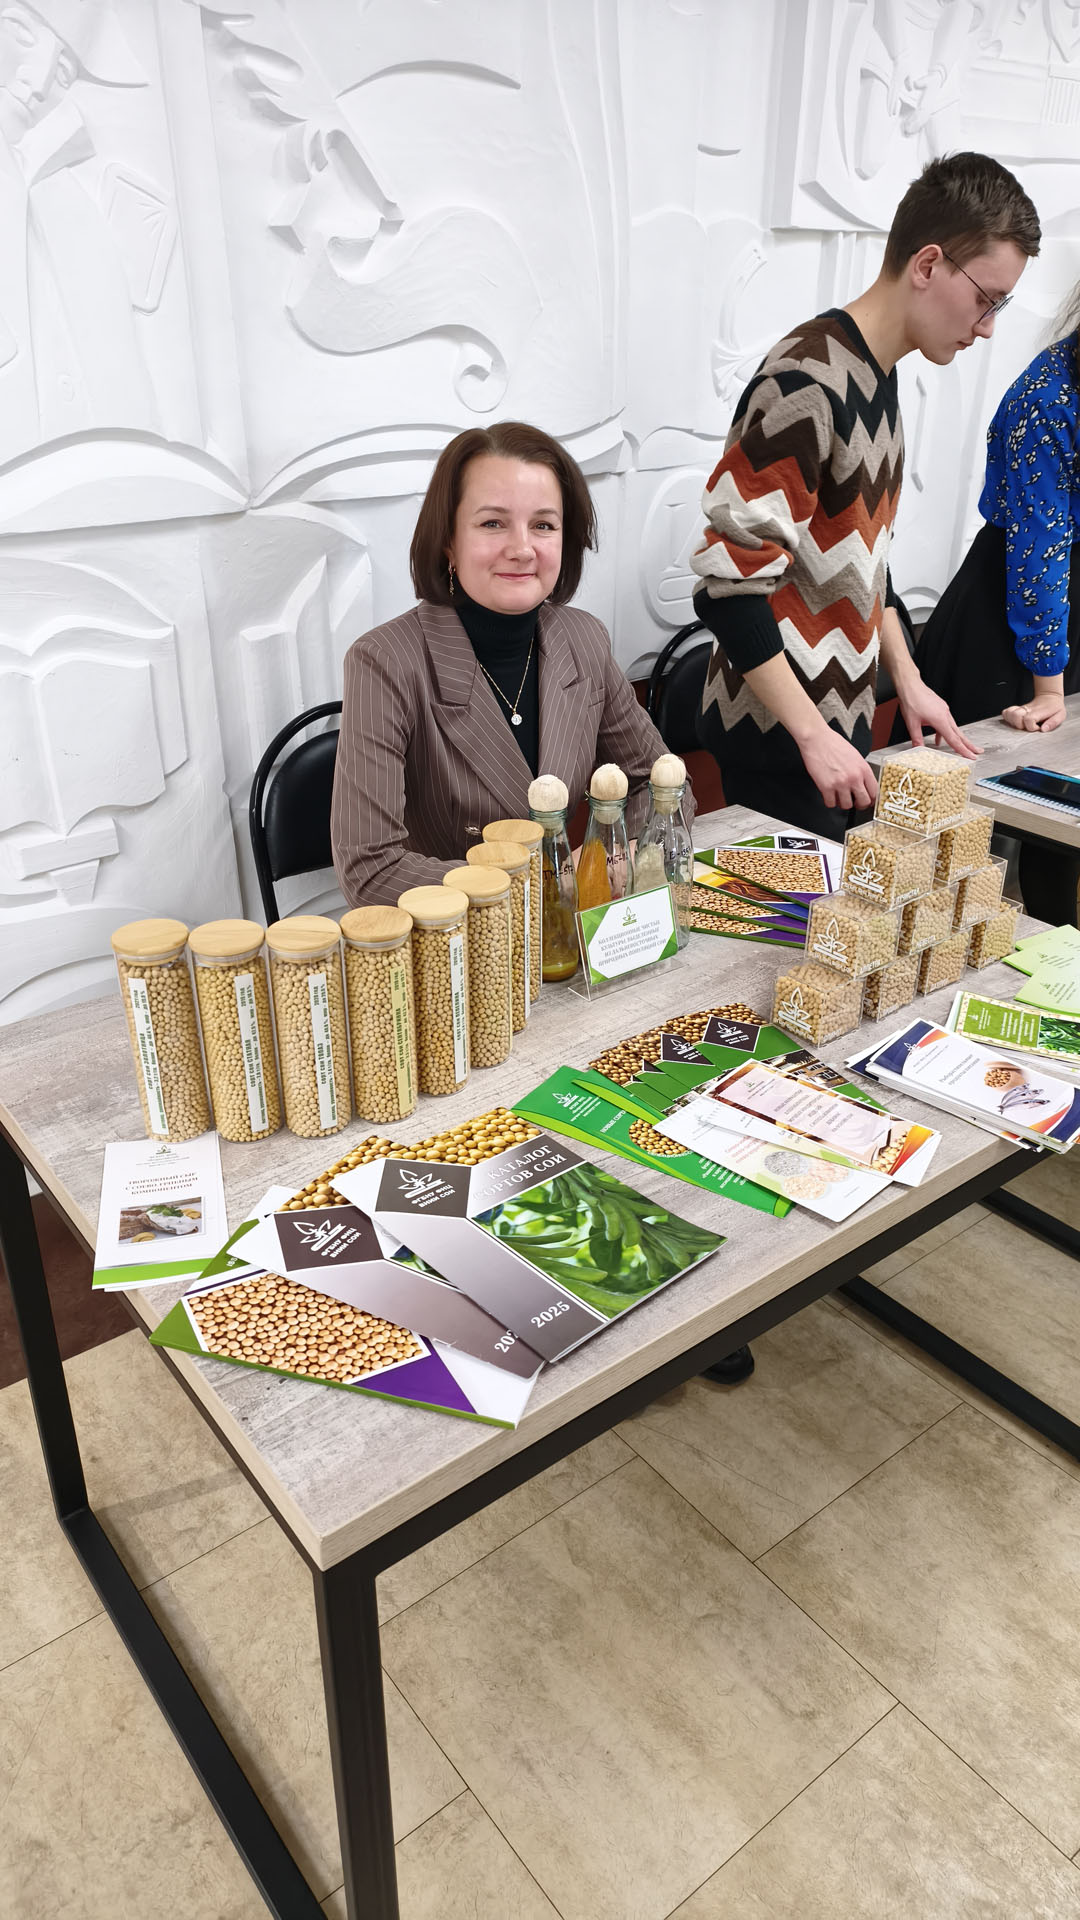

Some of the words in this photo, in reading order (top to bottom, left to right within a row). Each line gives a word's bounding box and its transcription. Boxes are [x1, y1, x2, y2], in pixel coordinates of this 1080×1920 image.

[488, 1145, 553, 1179] КАТАЛОГ
[533, 1154, 567, 1172] СОИ
[418, 1196, 440, 1208] ВНИИ
[440, 1189, 456, 1198] СОИ
[329, 1242, 349, 1258] ВНИИ
[346, 1232, 362, 1243] СОИ
[530, 1301, 570, 1328] 2025
[494, 1329, 519, 1353] 202
